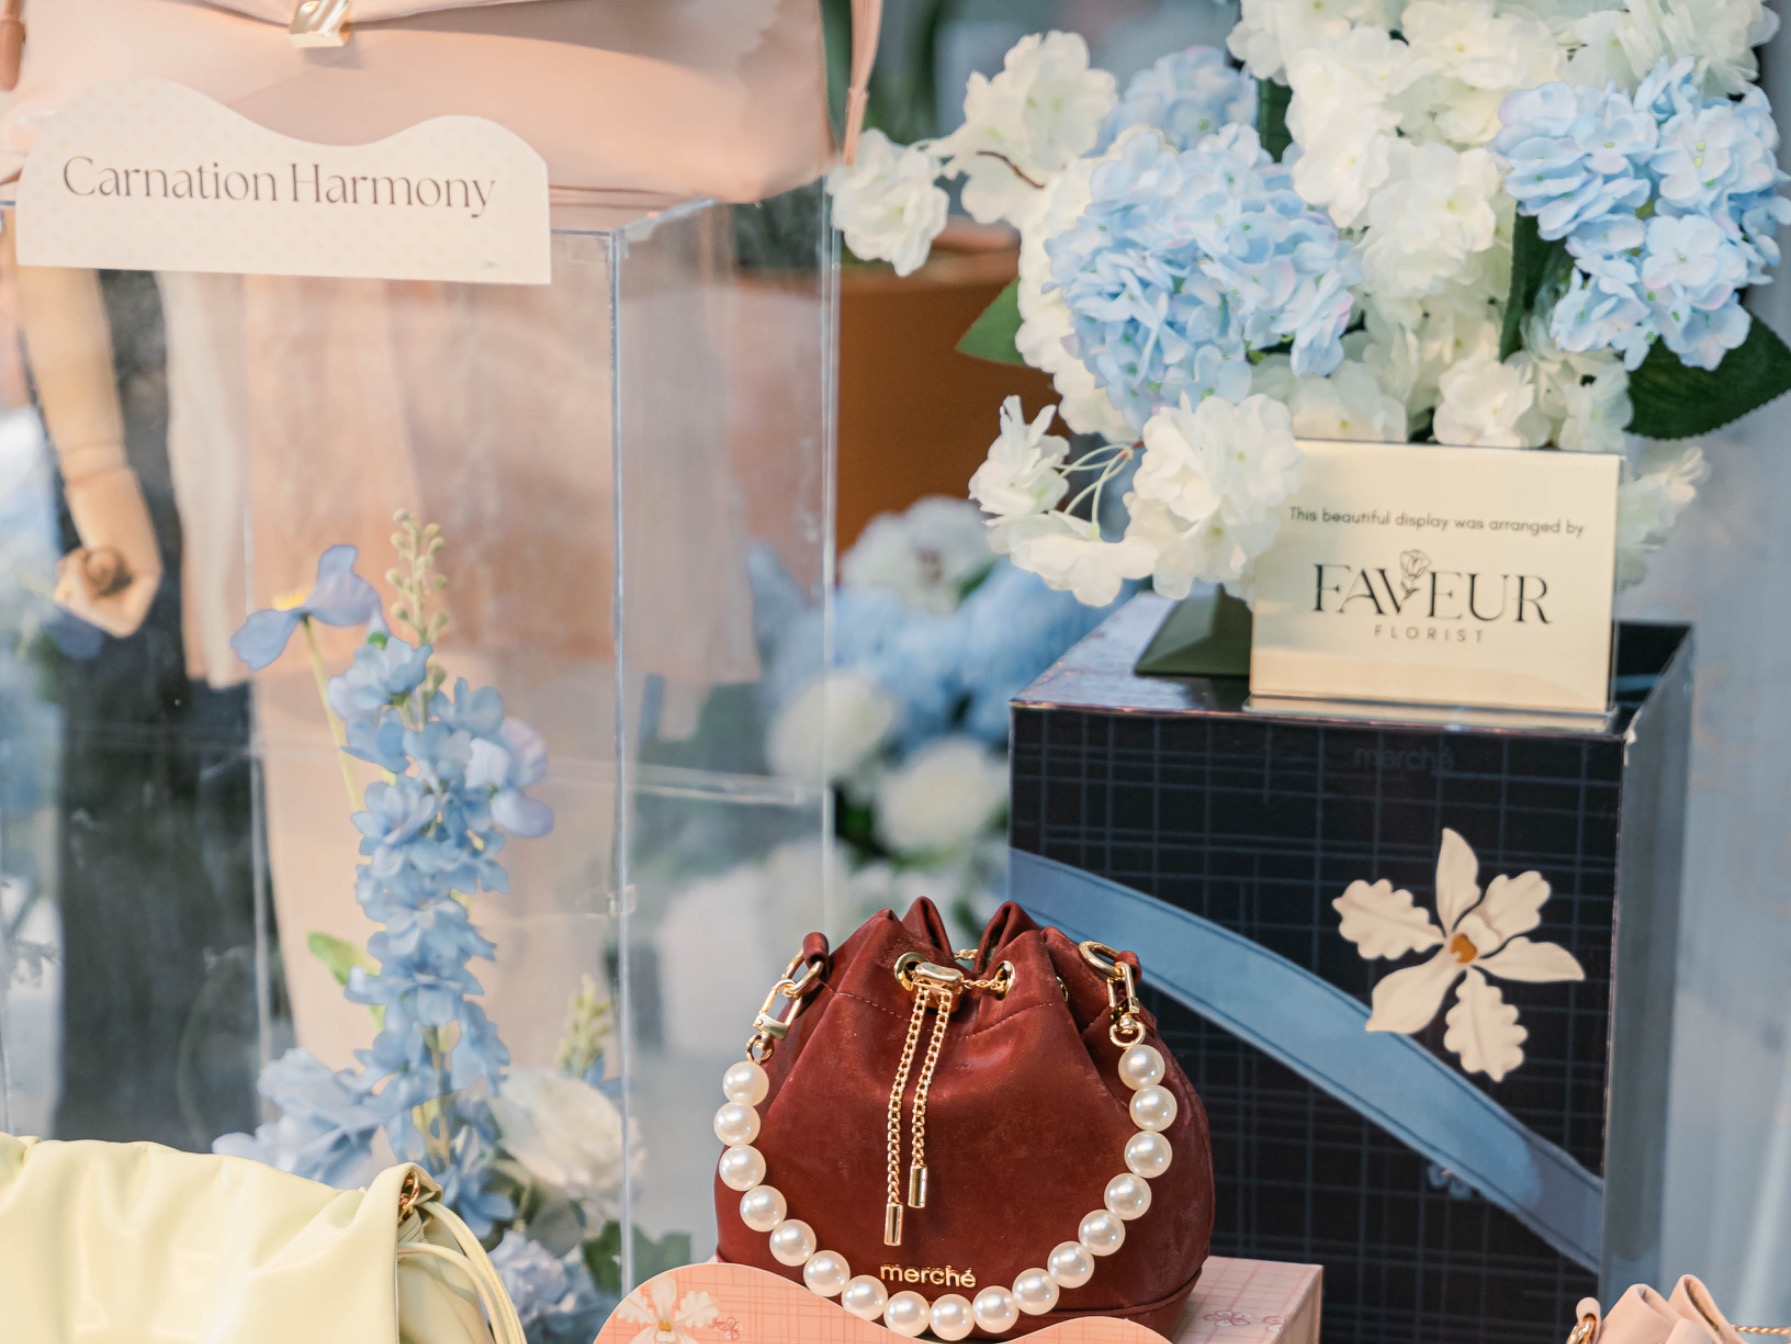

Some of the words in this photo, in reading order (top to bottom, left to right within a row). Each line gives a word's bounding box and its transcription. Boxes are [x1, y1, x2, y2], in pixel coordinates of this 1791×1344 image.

[62, 155, 278, 202] Carnation
[290, 163, 495, 219] Harmony
[1290, 506, 1317, 522] This
[1322, 508, 1390, 526] beautiful
[1395, 512, 1449, 532] display
[1454, 518, 1484, 530] was
[1489, 519, 1561, 537] arranged
[1566, 519, 1584, 538] by
[1374, 624, 1483, 644] FLORIST
[880, 1264, 977, 1289] merché
